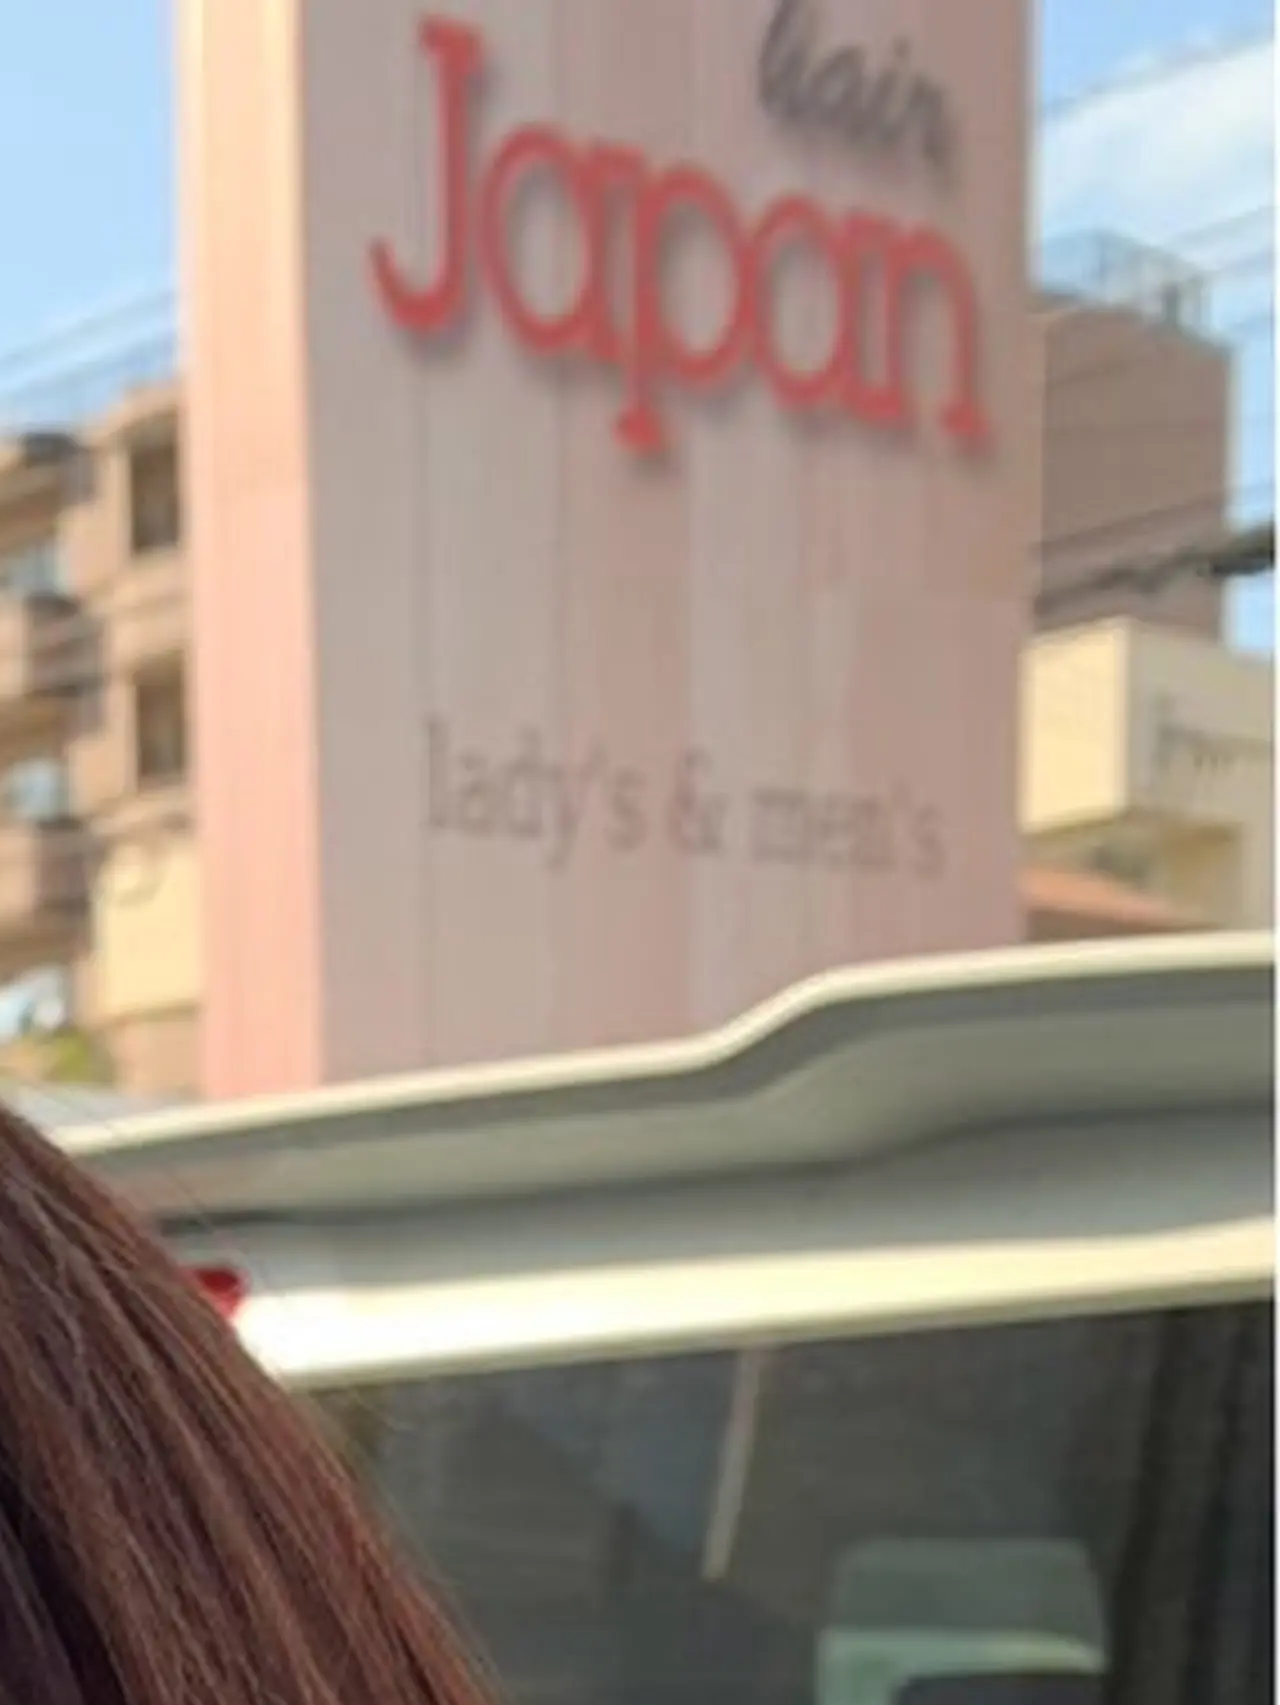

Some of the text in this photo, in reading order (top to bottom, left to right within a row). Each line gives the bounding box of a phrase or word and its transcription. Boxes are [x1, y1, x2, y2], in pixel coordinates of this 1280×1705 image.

[371, 12, 990, 454] Japan
[420, 712, 648, 872] lady's
[666, 746, 730, 856] &
